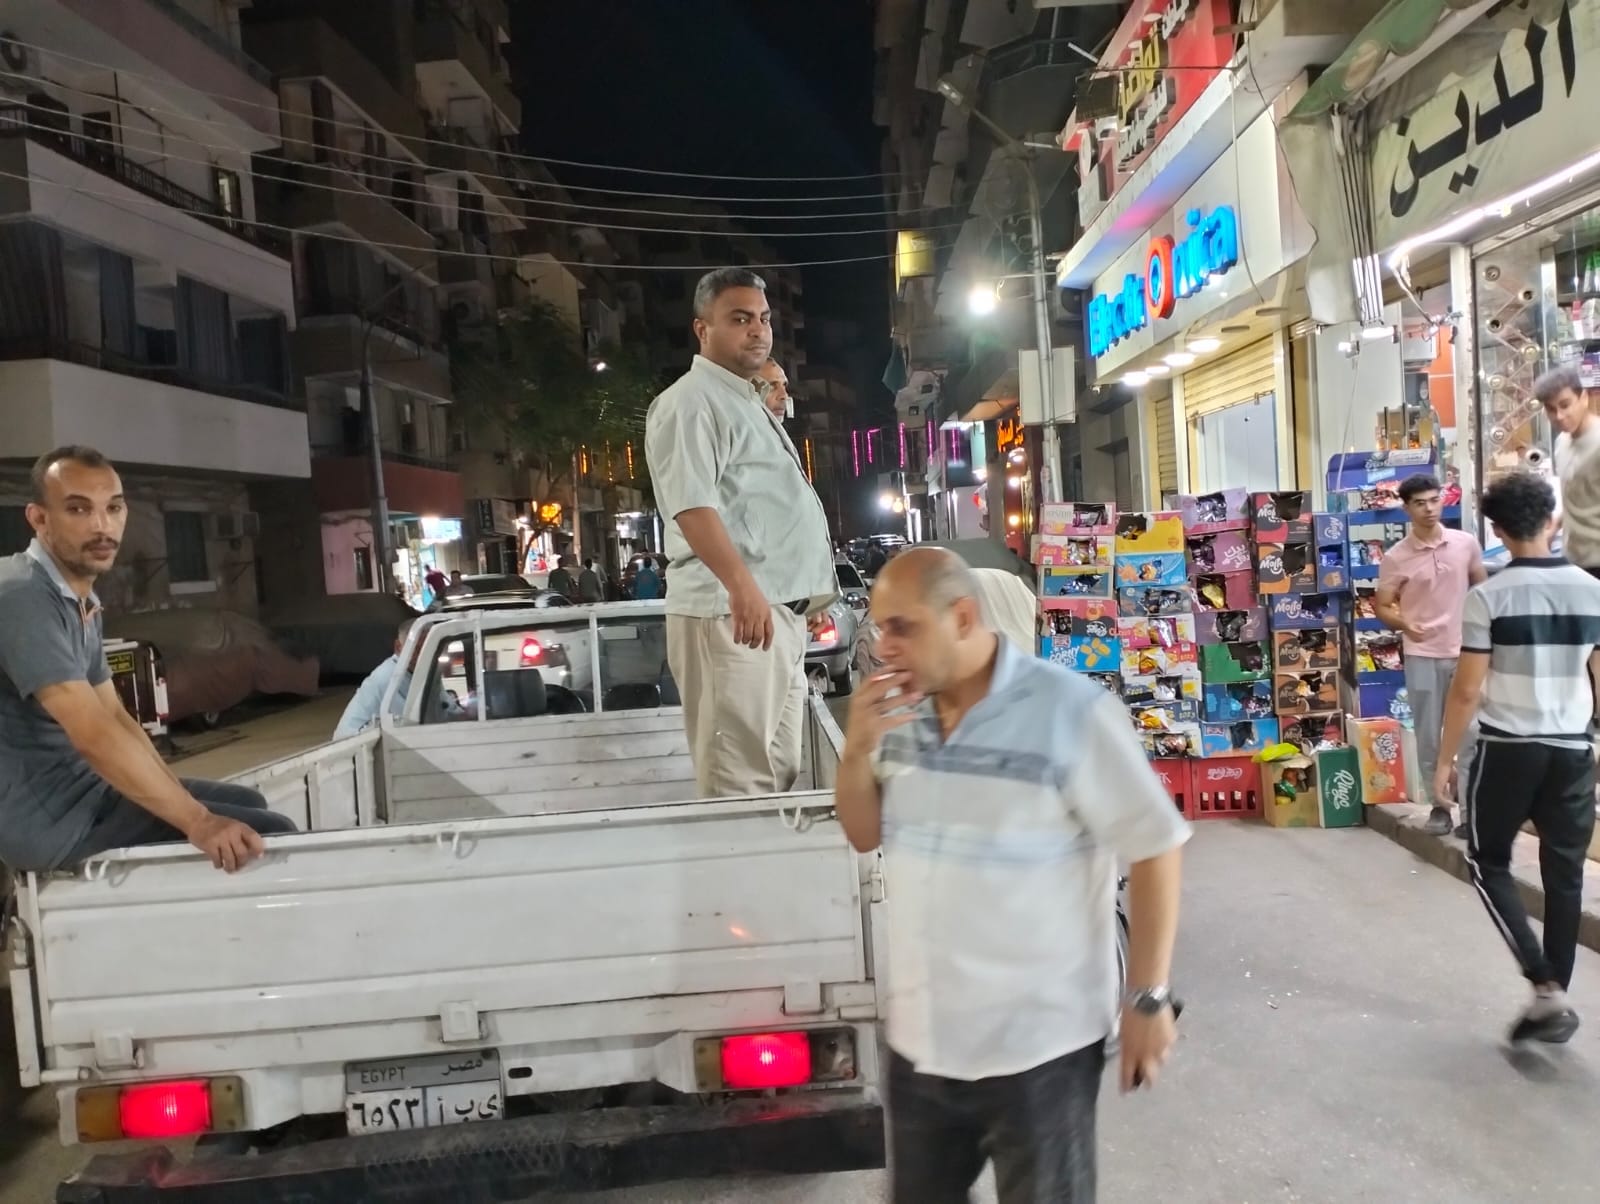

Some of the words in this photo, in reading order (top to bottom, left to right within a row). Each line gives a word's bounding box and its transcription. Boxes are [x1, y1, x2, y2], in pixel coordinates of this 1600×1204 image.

[1274, 600, 1303, 619] Molto
[1331, 769, 1355, 810] Ringo
[361, 1066, 406, 1084] EGYPT
[441, 1058, 483, 1076] مصر
